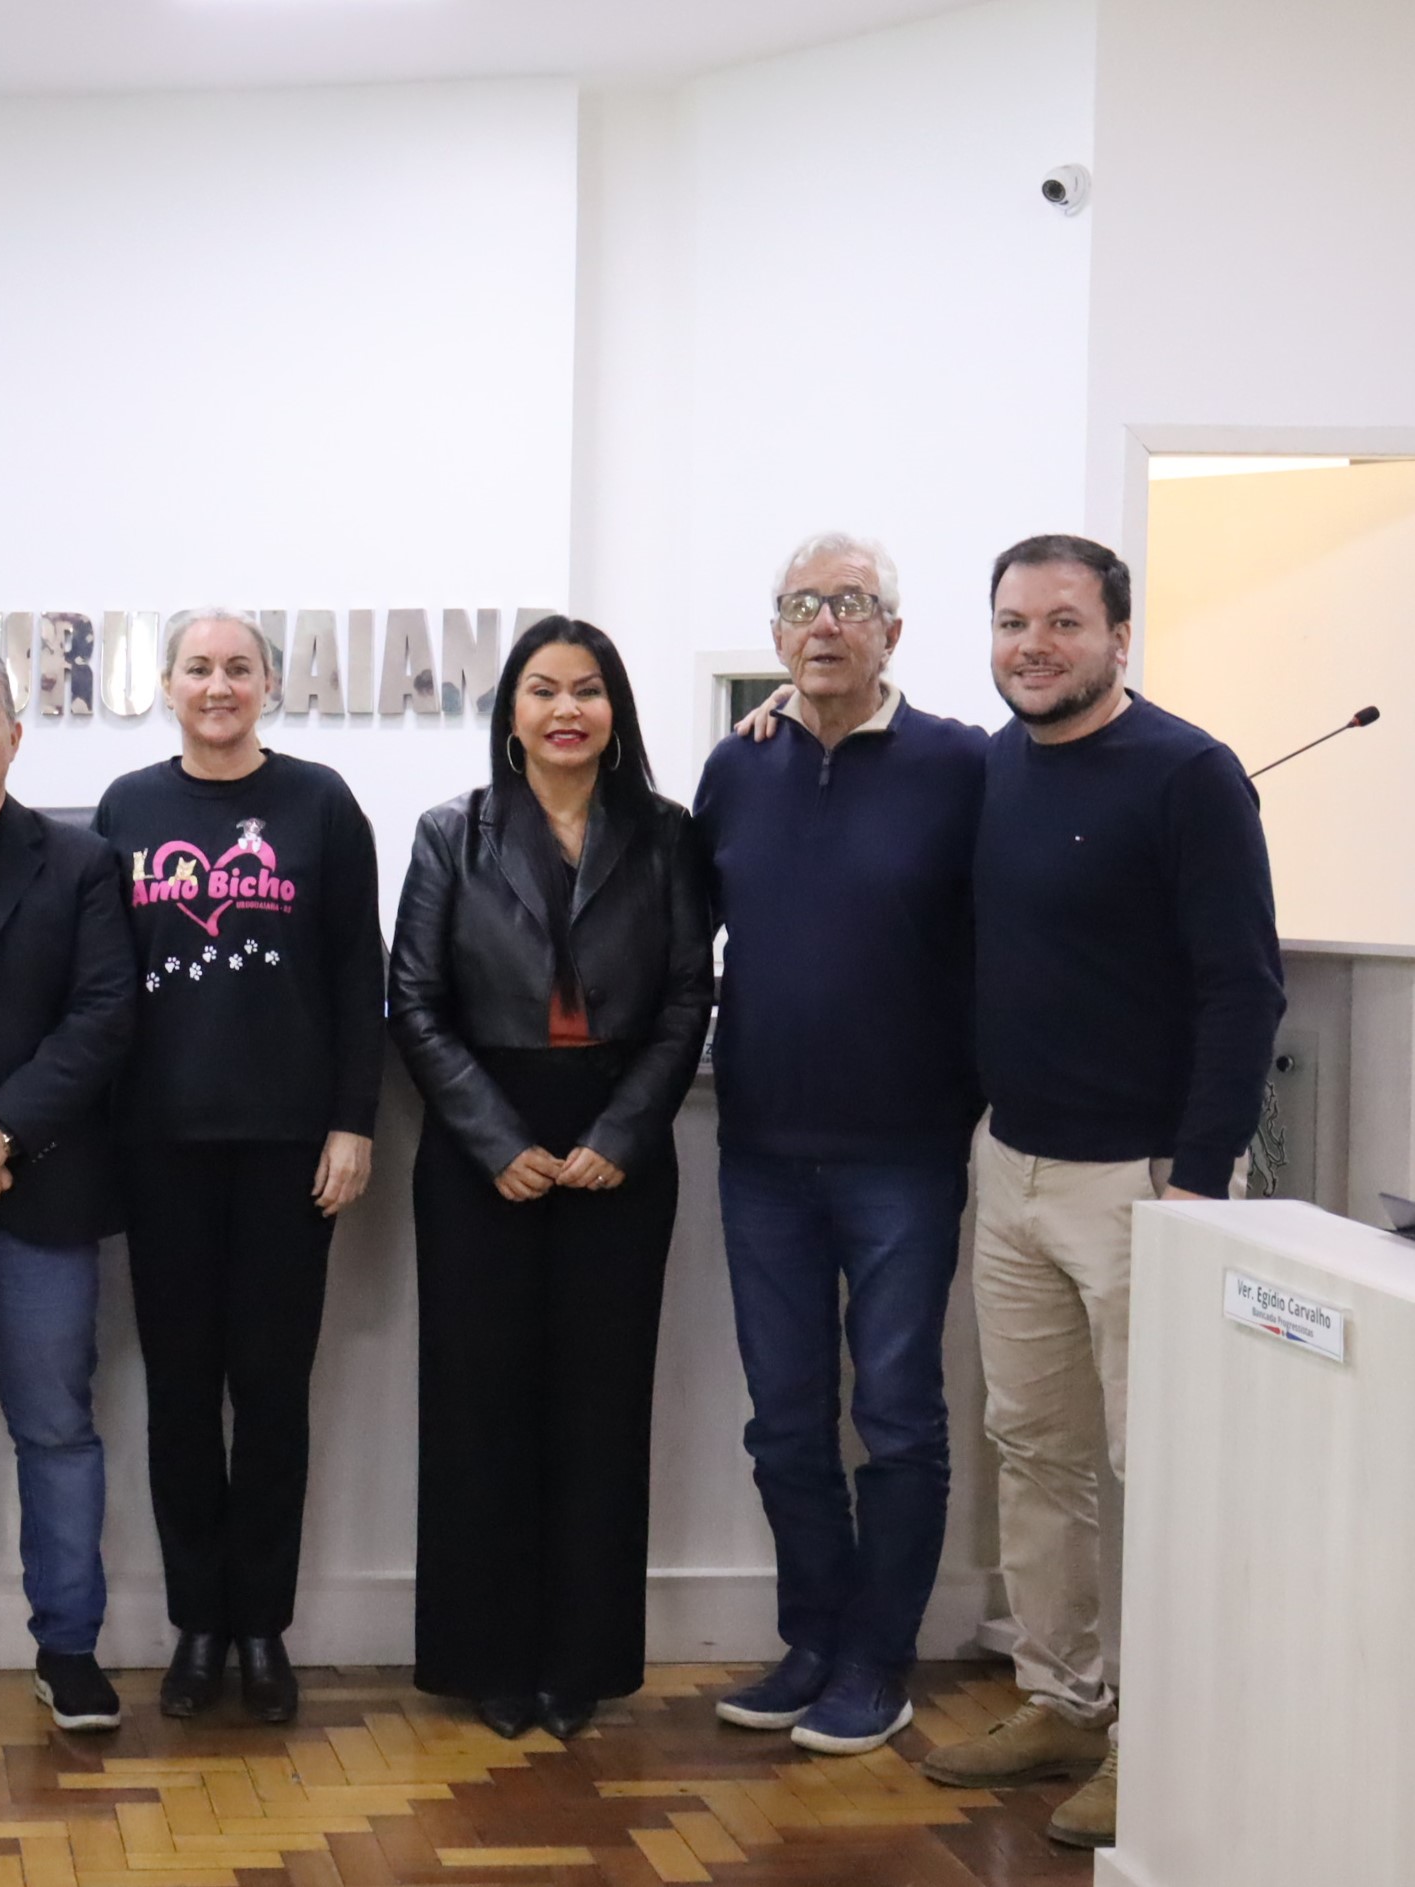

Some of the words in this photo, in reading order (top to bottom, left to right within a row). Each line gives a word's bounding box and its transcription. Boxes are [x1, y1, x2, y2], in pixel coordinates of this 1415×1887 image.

[132, 872, 199, 907] Amo
[208, 868, 295, 901] Bicho
[1237, 1279, 1254, 1300] Ver.
[1288, 1298, 1331, 1329] Carvalho
